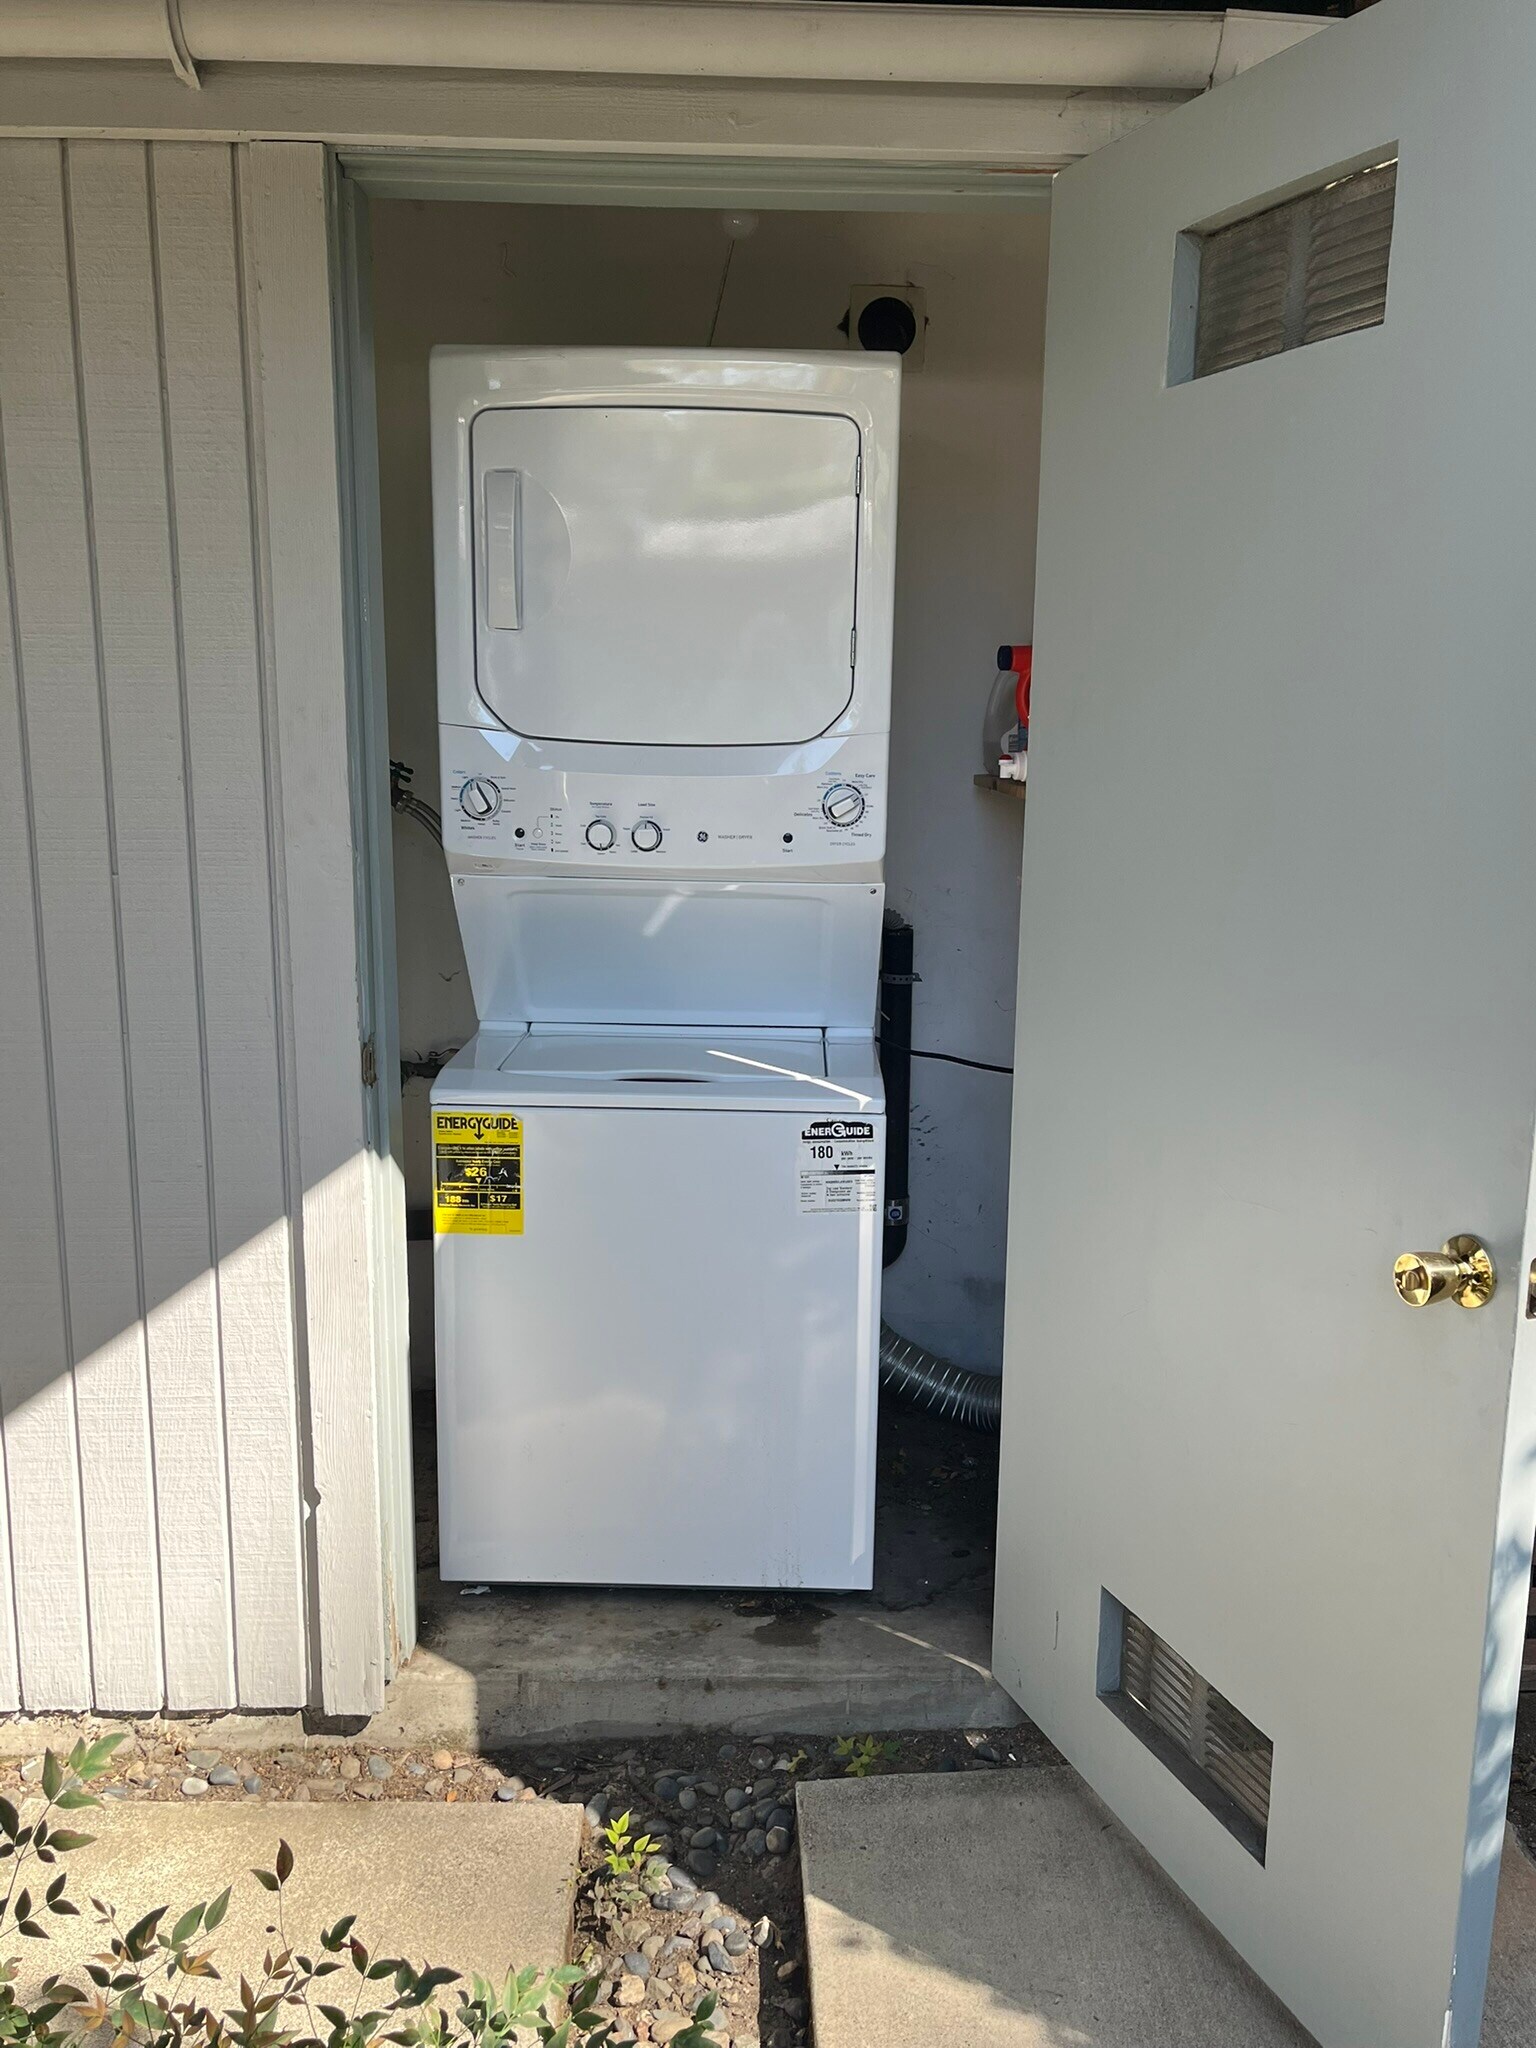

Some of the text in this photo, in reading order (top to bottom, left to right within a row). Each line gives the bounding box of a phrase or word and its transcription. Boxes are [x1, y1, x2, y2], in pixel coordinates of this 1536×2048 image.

[804, 1123, 871, 1137] ENERGUIDE
[810, 1146, 833, 1158] 180
[464, 1167, 487, 1177] $26
[489, 1195, 507, 1203] $17
